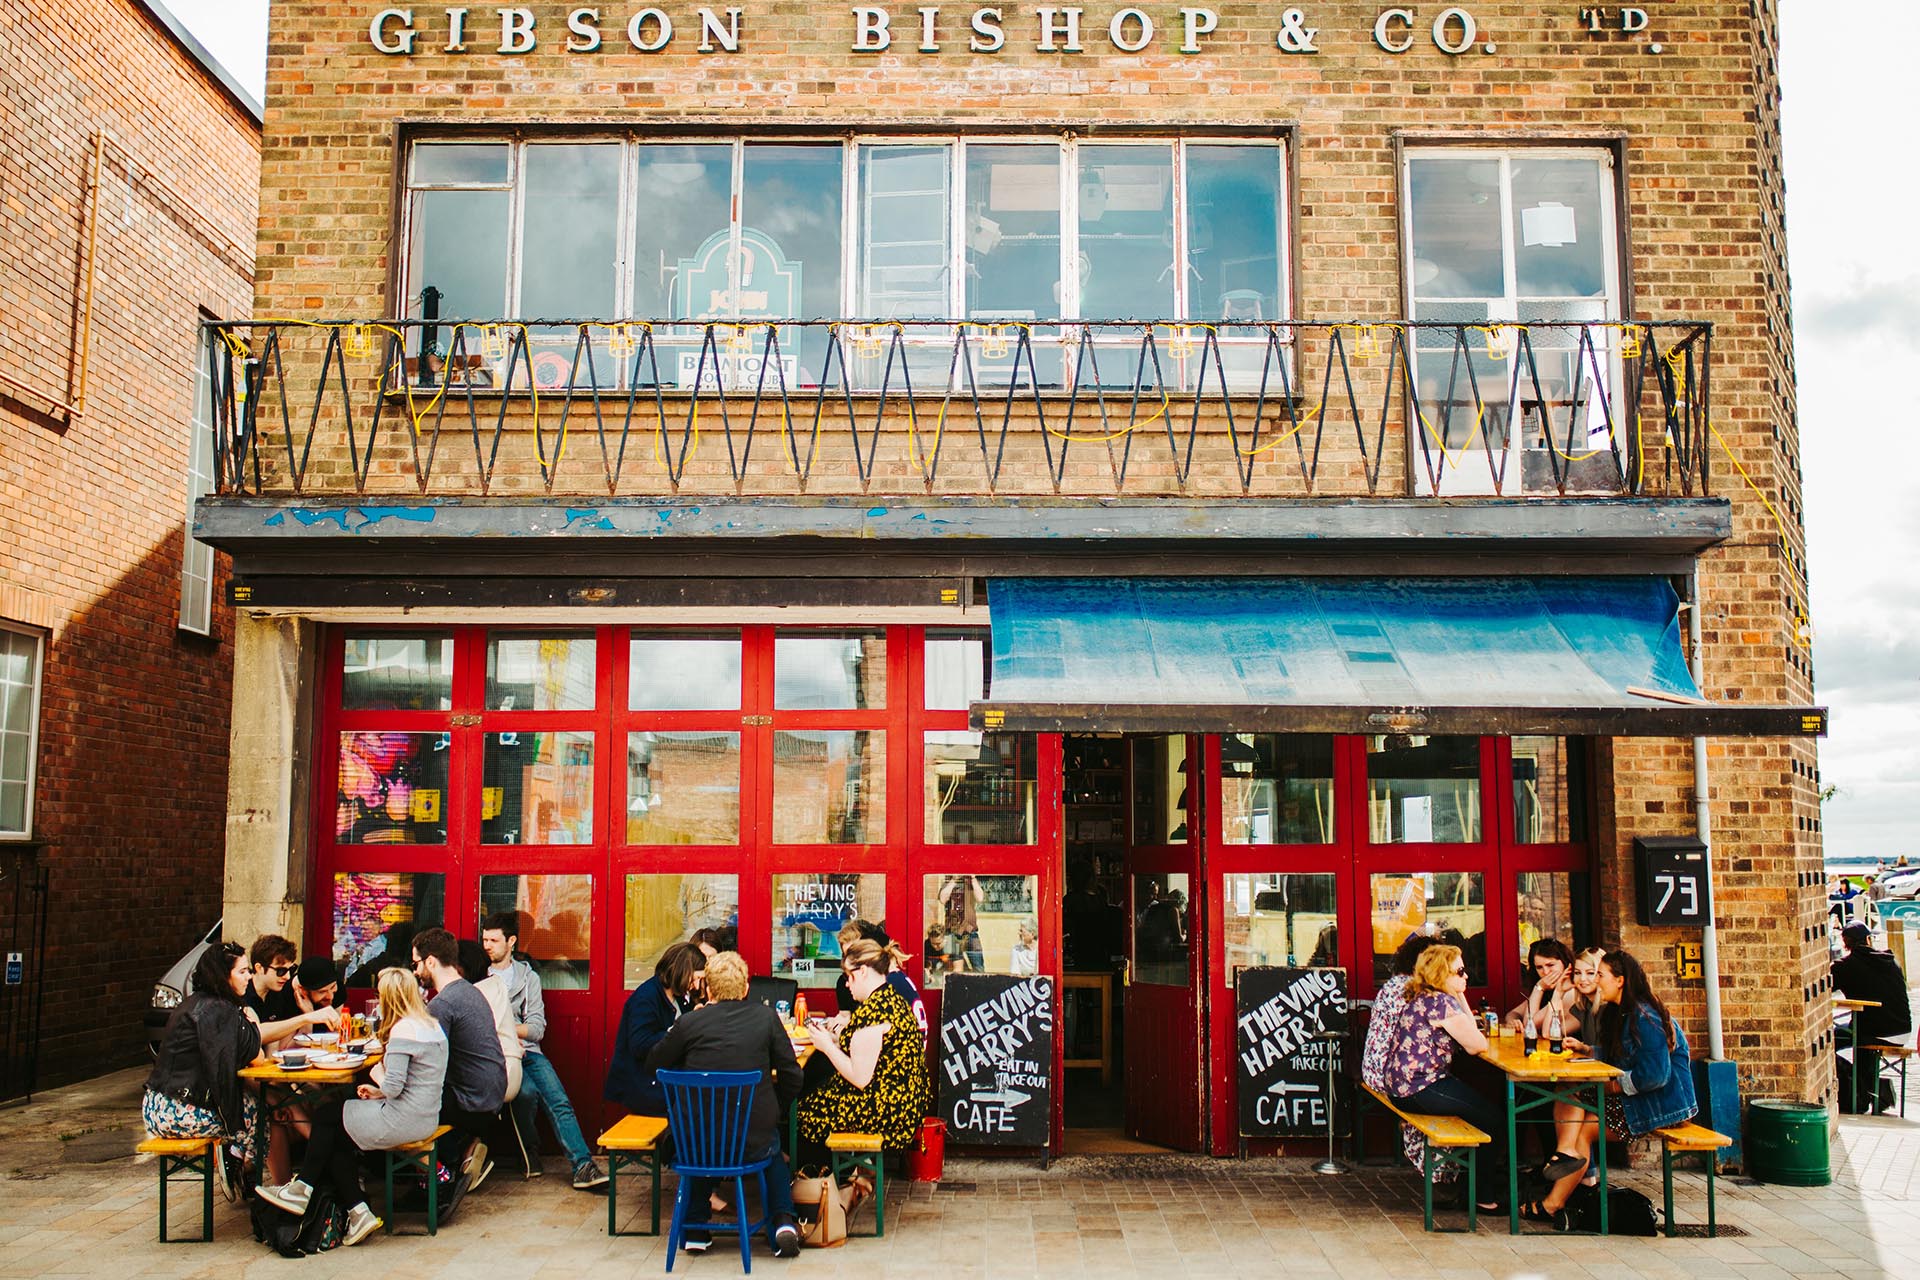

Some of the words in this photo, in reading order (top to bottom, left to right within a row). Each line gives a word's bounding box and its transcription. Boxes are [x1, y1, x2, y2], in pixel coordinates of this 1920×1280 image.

[369, 7, 742, 54] GIBSON
[851, 7, 1218, 54] BISHOP
[1277, 8, 1319, 54] &
[1374, 7, 1497, 54] CO.
[782, 883, 856, 901] THIEVING
[1655, 875, 1699, 915] 73
[785, 902, 858, 920] HARRY'S
[1690, 948, 1696, 957] 3
[1690, 965, 1696, 974] 4
[941, 976, 1052, 1053] THIEVING
[1238, 970, 1337, 1043] THIEVING
[943, 1002, 1053, 1087] HARRY'S
[1241, 989, 1348, 1077] HARRY'S
[1301, 1042, 1325, 1055] EAT
[1024, 1061, 1039, 1074] IN
[953, 1099, 1017, 1134] CAFE
[1256, 1096, 1327, 1127] CAFE
